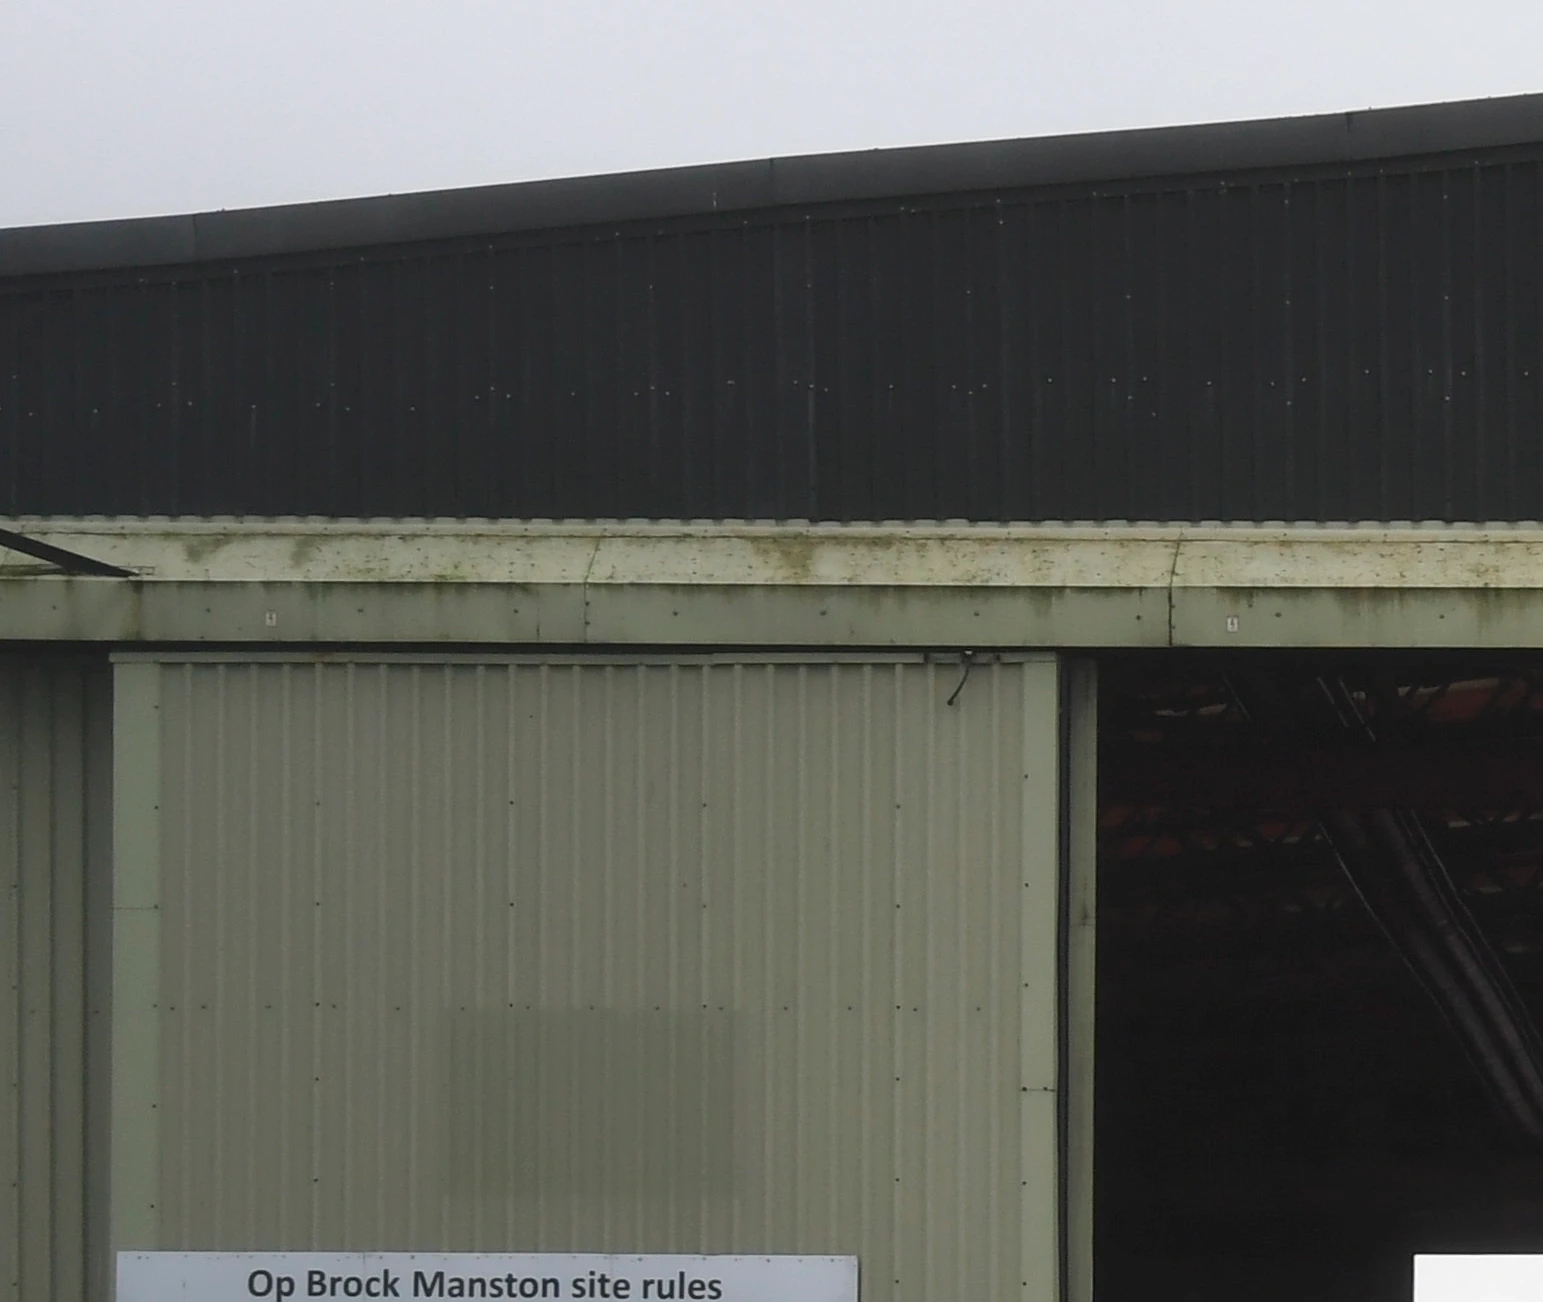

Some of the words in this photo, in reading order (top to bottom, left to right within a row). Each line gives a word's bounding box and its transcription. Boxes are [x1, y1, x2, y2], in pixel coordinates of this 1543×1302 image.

[248, 1270, 294, 1302] Op
[308, 1269, 399, 1297] Brock
[414, 1271, 559, 1298] Manston
[572, 1274, 630, 1299] site
[643, 1272, 721, 1299] rules
